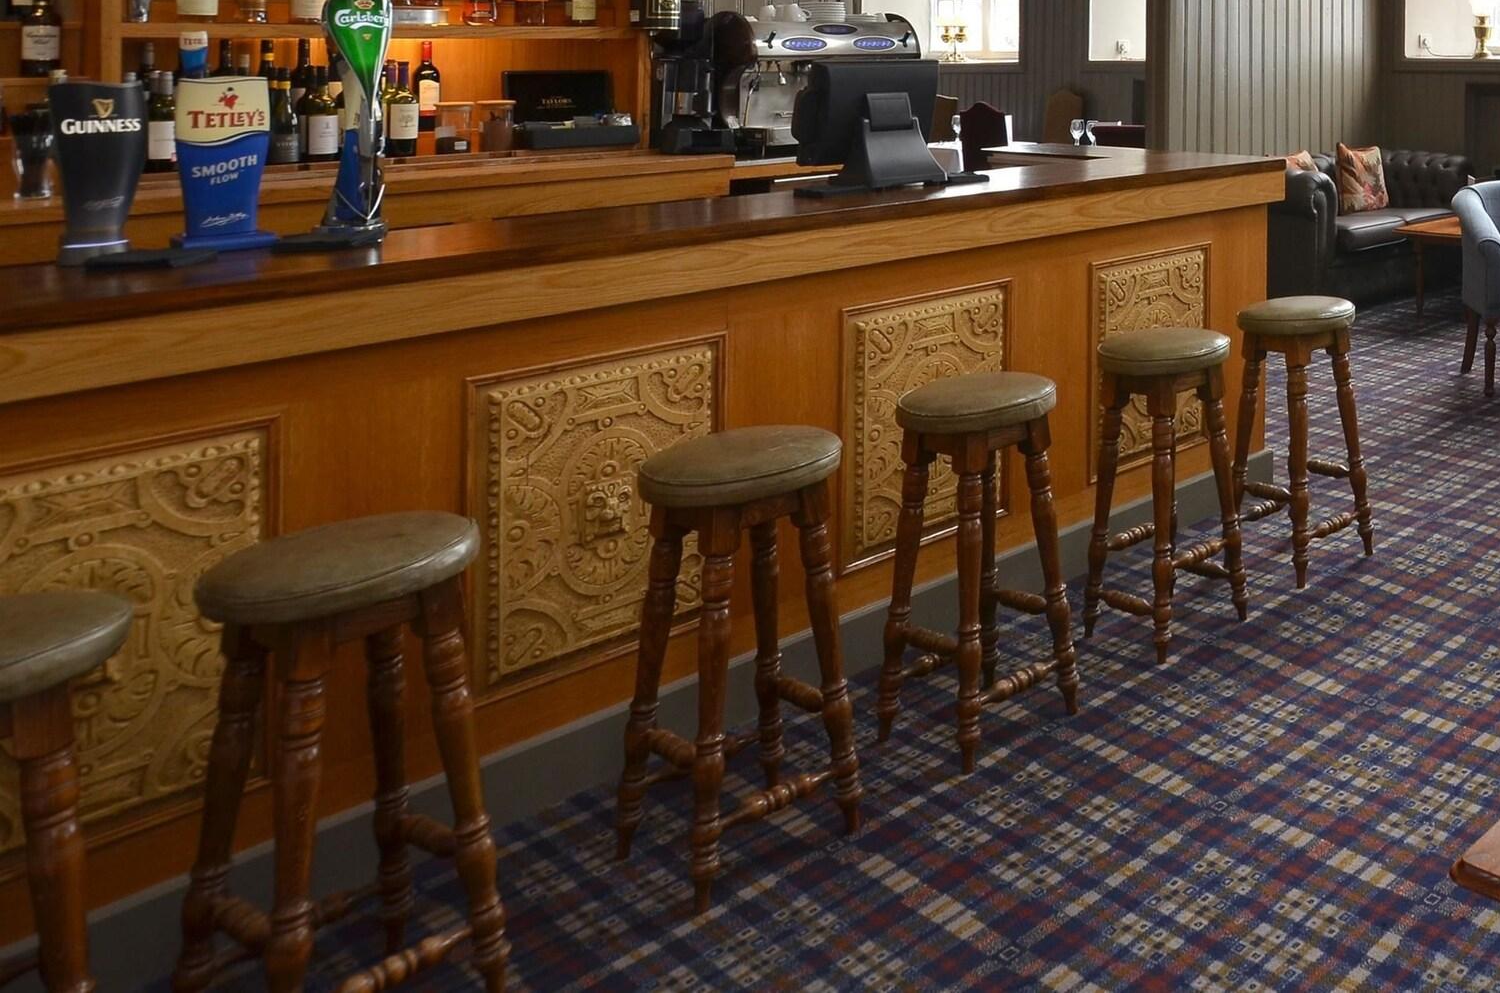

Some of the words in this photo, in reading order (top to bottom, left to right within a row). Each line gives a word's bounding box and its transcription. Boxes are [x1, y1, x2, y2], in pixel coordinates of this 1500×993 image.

[61, 117, 142, 135] GUINNESS
[186, 108, 266, 129] TETLEY'S
[191, 154, 258, 179] SMOOTH
[210, 171, 239, 186] FLOW
